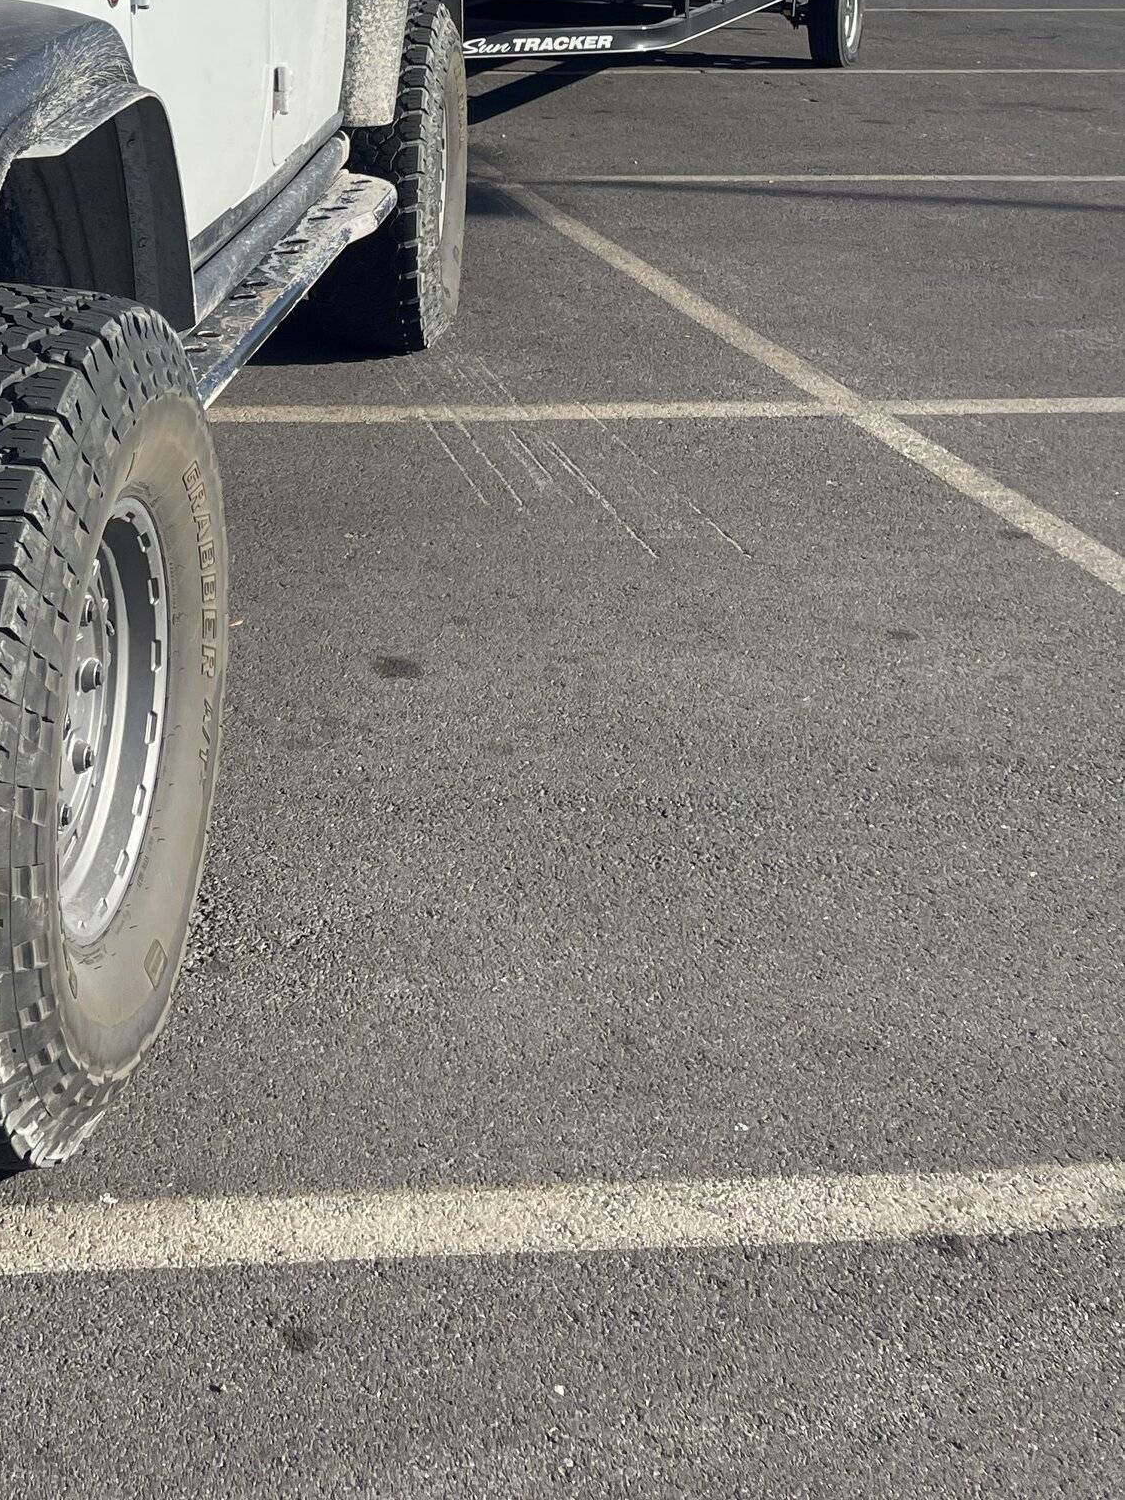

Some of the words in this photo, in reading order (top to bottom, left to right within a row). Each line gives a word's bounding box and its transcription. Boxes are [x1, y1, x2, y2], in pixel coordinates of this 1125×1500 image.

[462, 37, 510, 55] Sun
[512, 35, 613, 52] TRACKER
[182, 460, 218, 679] GRABBER
